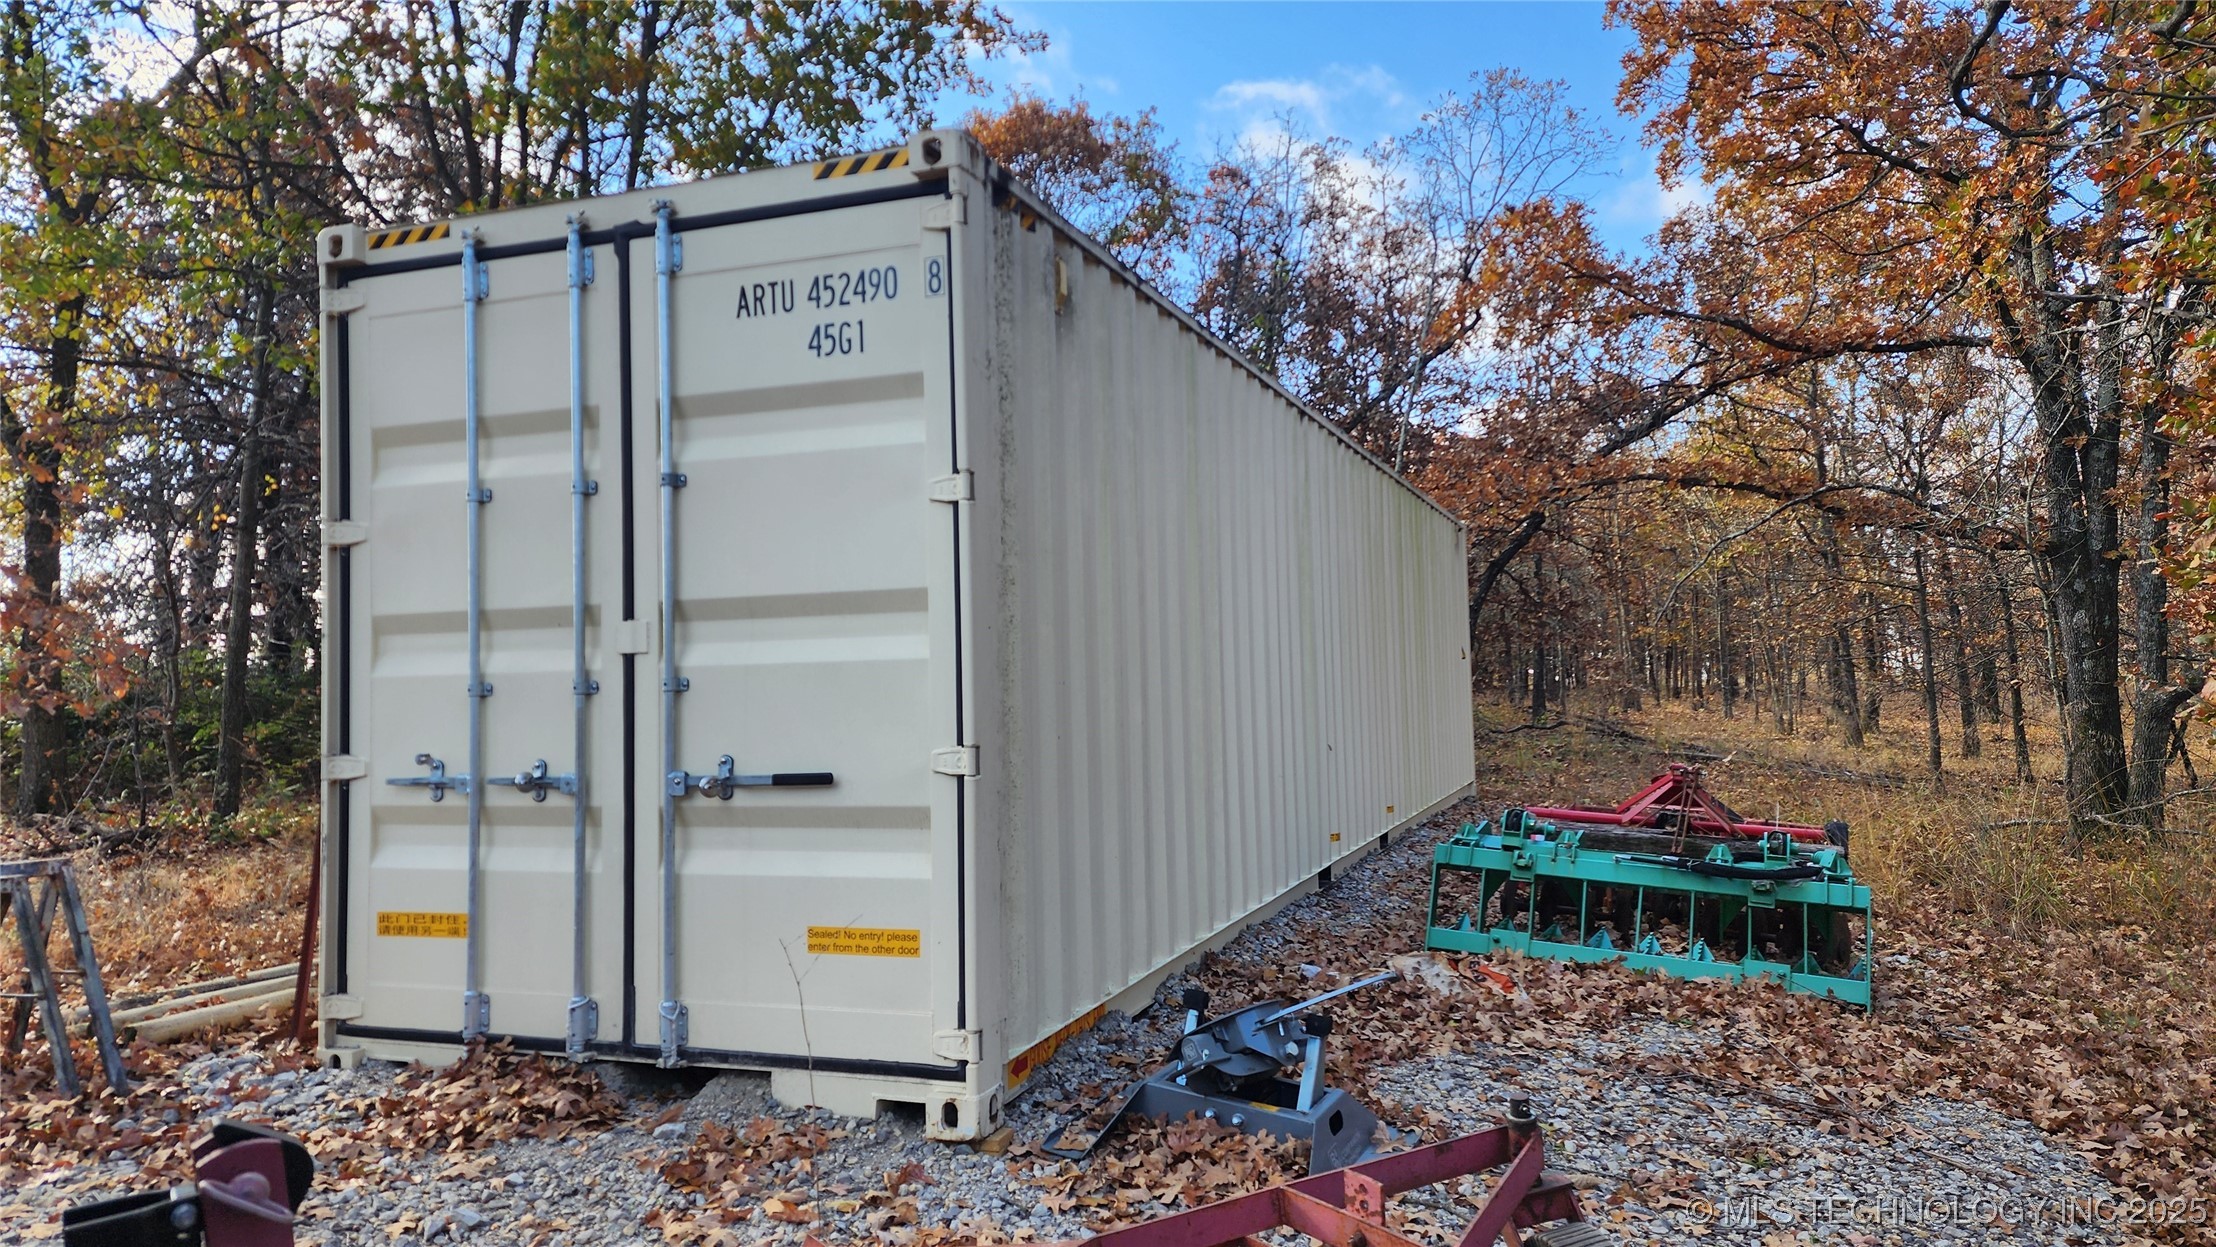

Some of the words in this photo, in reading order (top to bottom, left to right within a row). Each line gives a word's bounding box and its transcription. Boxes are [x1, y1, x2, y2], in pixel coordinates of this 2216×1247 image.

[736, 279, 795, 319] ARTU
[807, 265, 899, 309] 452490
[927, 259, 942, 294] 8
[808, 319, 865, 358] 45G1
[807, 928, 841, 940] Sealed!
[843, 930, 857, 940] No
[858, 932, 884, 944] entry!
[886, 932, 918, 943] please
[807, 943, 831, 952] enter
[832, 942, 853, 953] from
[855, 944, 869, 954] the
[871, 945, 895, 954] other
[897, 945, 919, 955] door
